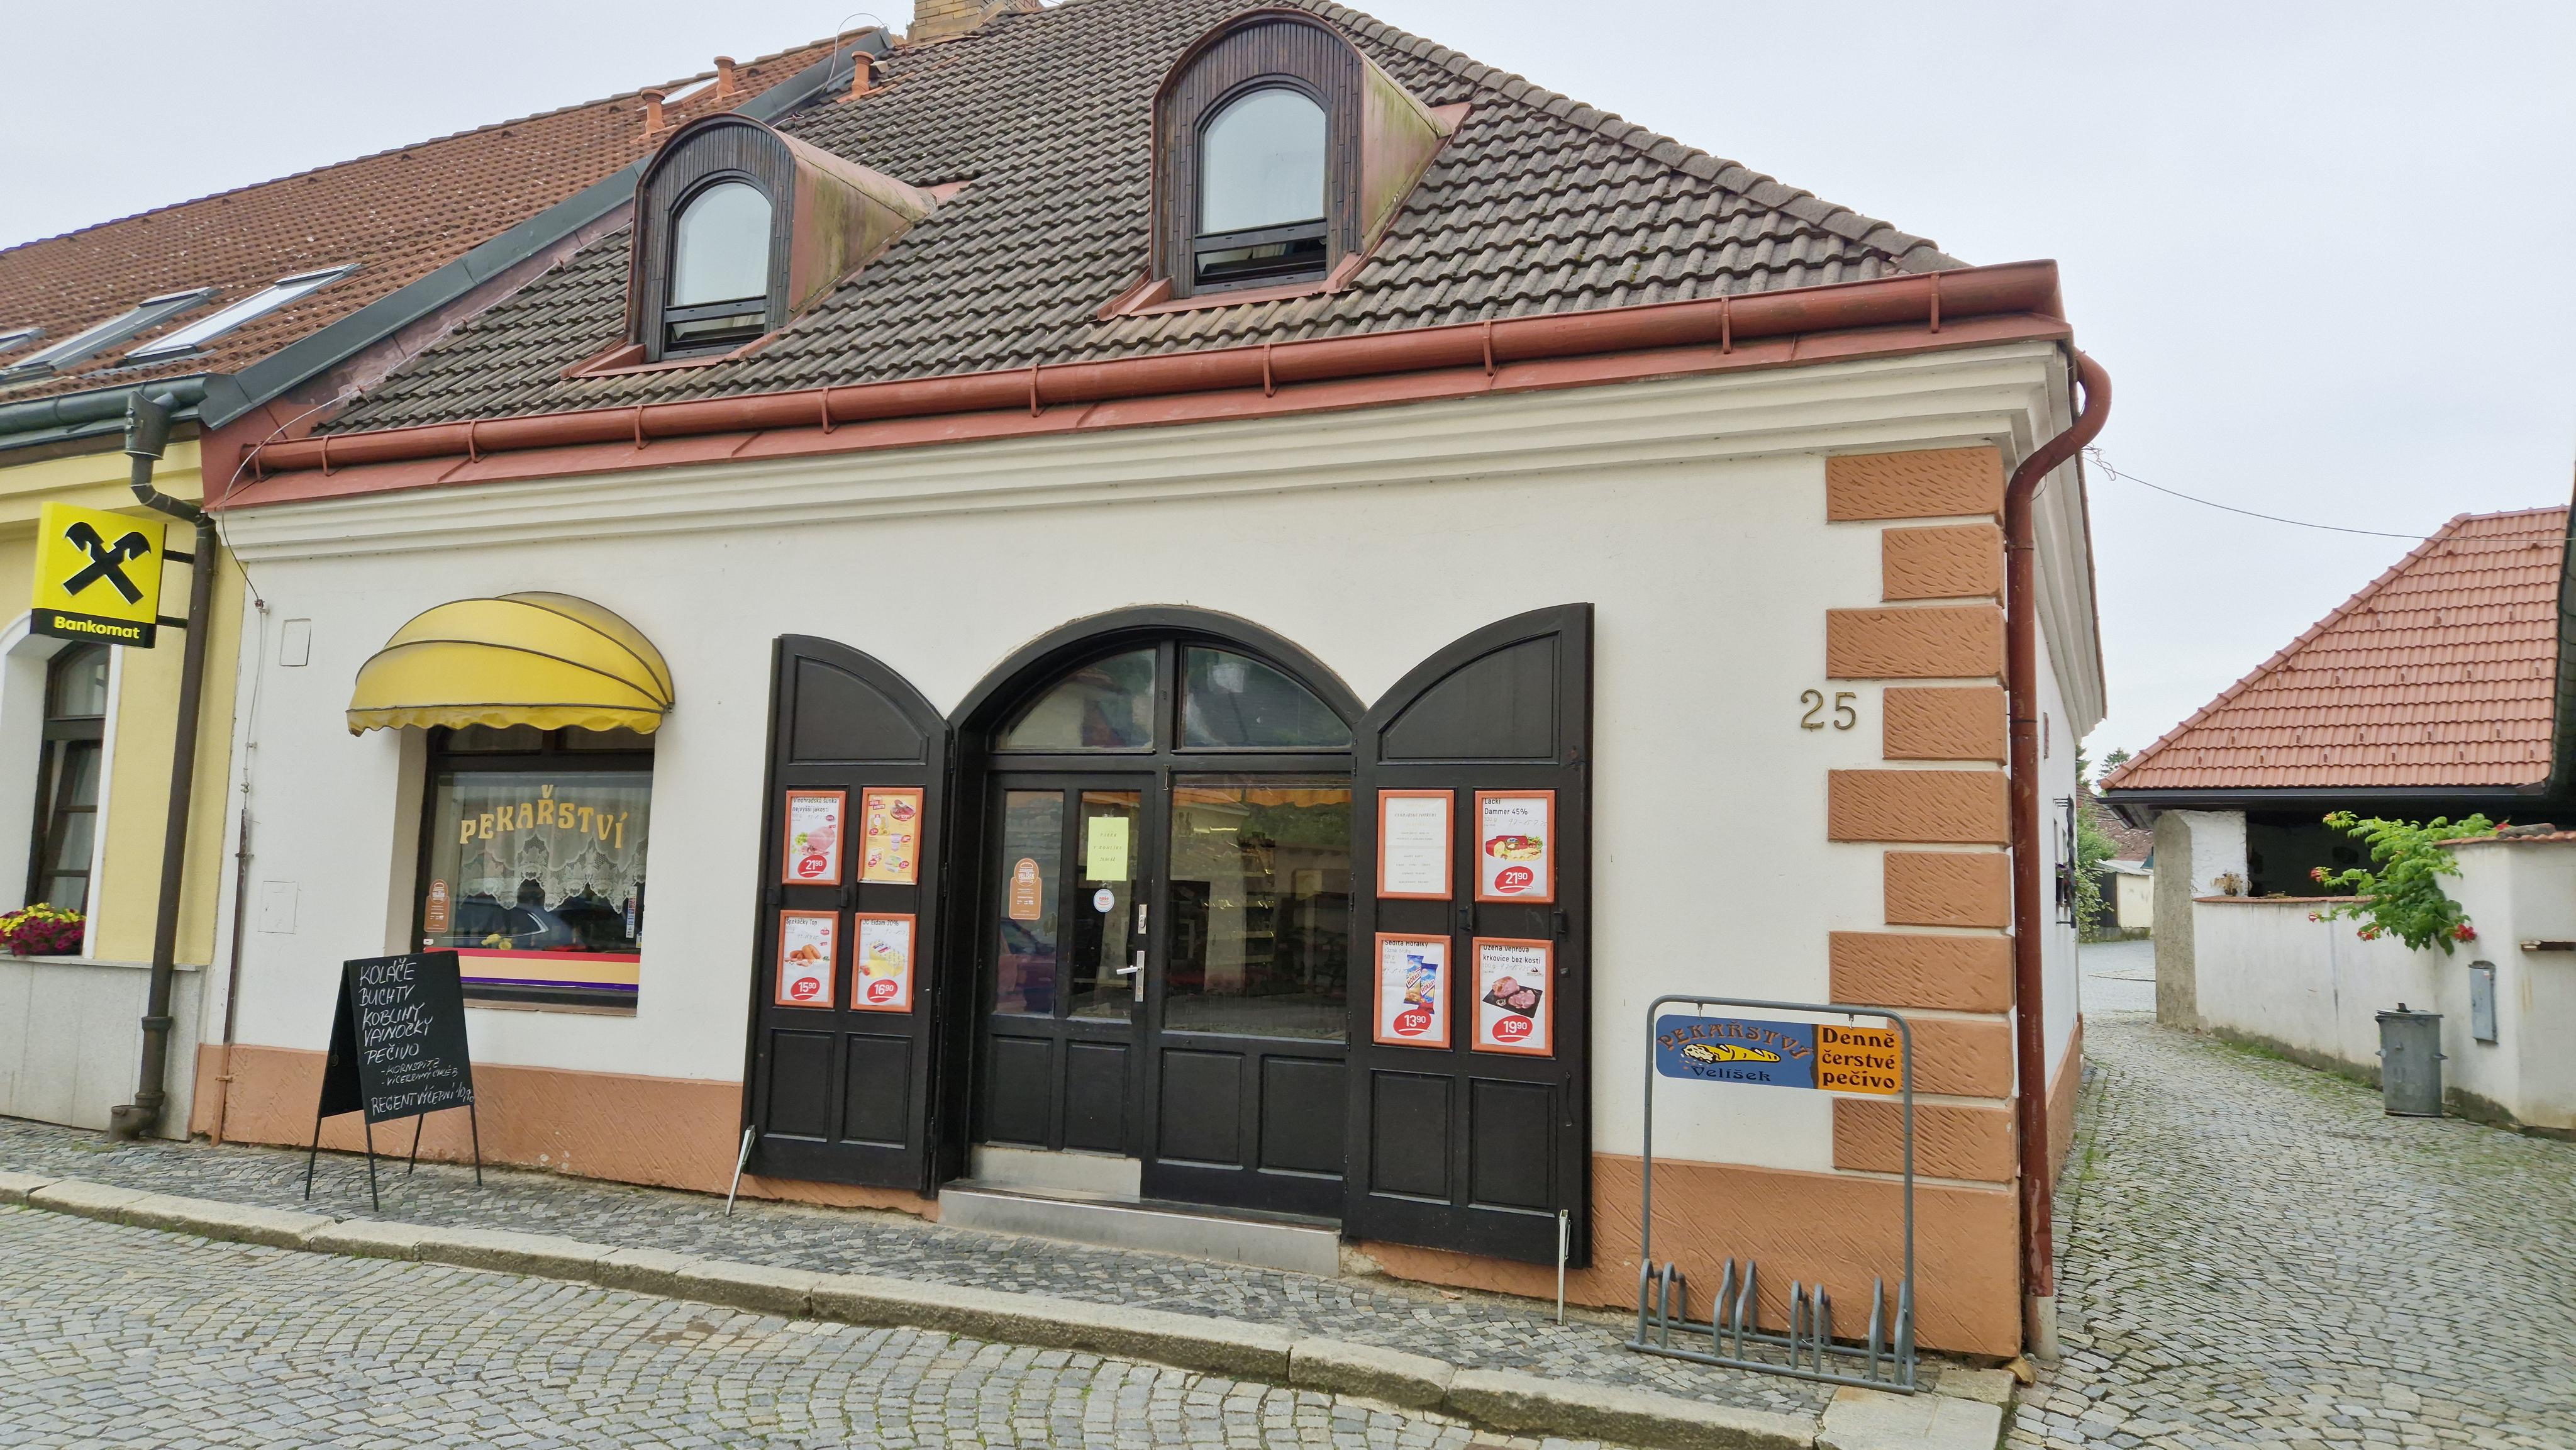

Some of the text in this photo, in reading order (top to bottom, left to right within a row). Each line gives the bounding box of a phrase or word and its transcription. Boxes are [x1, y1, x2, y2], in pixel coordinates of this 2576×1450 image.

[53, 616, 140, 639] Bankomat
[1801, 689, 1856, 730] 25
[459, 784, 628, 849] PEKAŘSTVÍ
[1483, 951, 1509, 962] krkovice
[359, 957, 417, 986] KOLÁČE
[362, 1002, 425, 1030] KOBLIHY
[1657, 1021, 1815, 1060] PEKAŘSTVÍ
[1822, 1027, 1895, 1048] Denně
[364, 1043, 419, 1065] PEČIVO
[1821, 1049, 1895, 1069] čerstvé
[1692, 1066, 1771, 1082] Velíšek
[370, 1093, 417, 1116] REGENT
